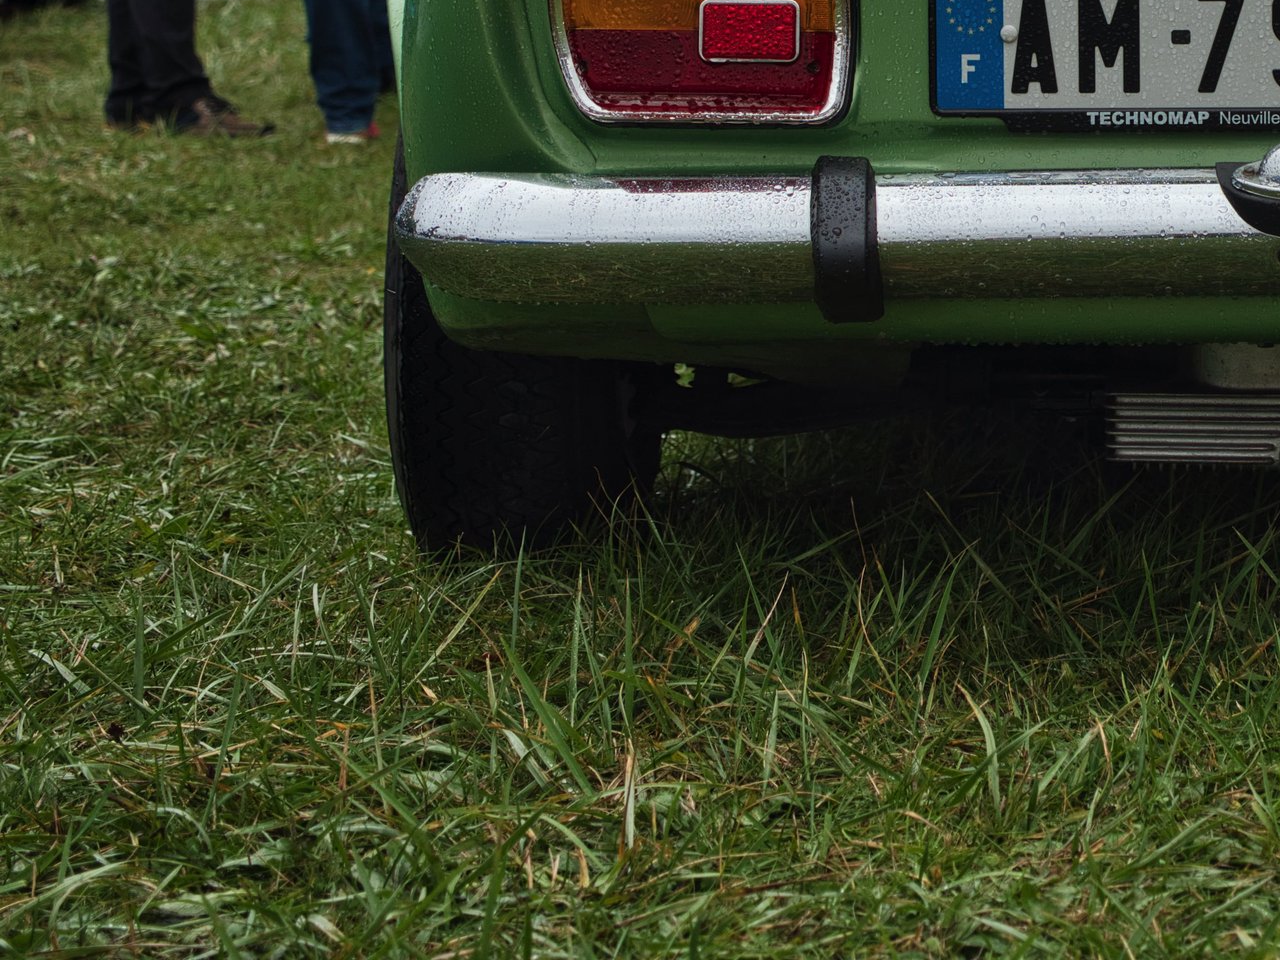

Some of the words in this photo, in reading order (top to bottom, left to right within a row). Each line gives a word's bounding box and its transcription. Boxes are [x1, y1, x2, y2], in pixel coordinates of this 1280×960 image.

[961, 53, 981, 84] F
[1087, 111, 1210, 125] TECHNOMAP
[1219, 110, 1280, 125] Neuville
